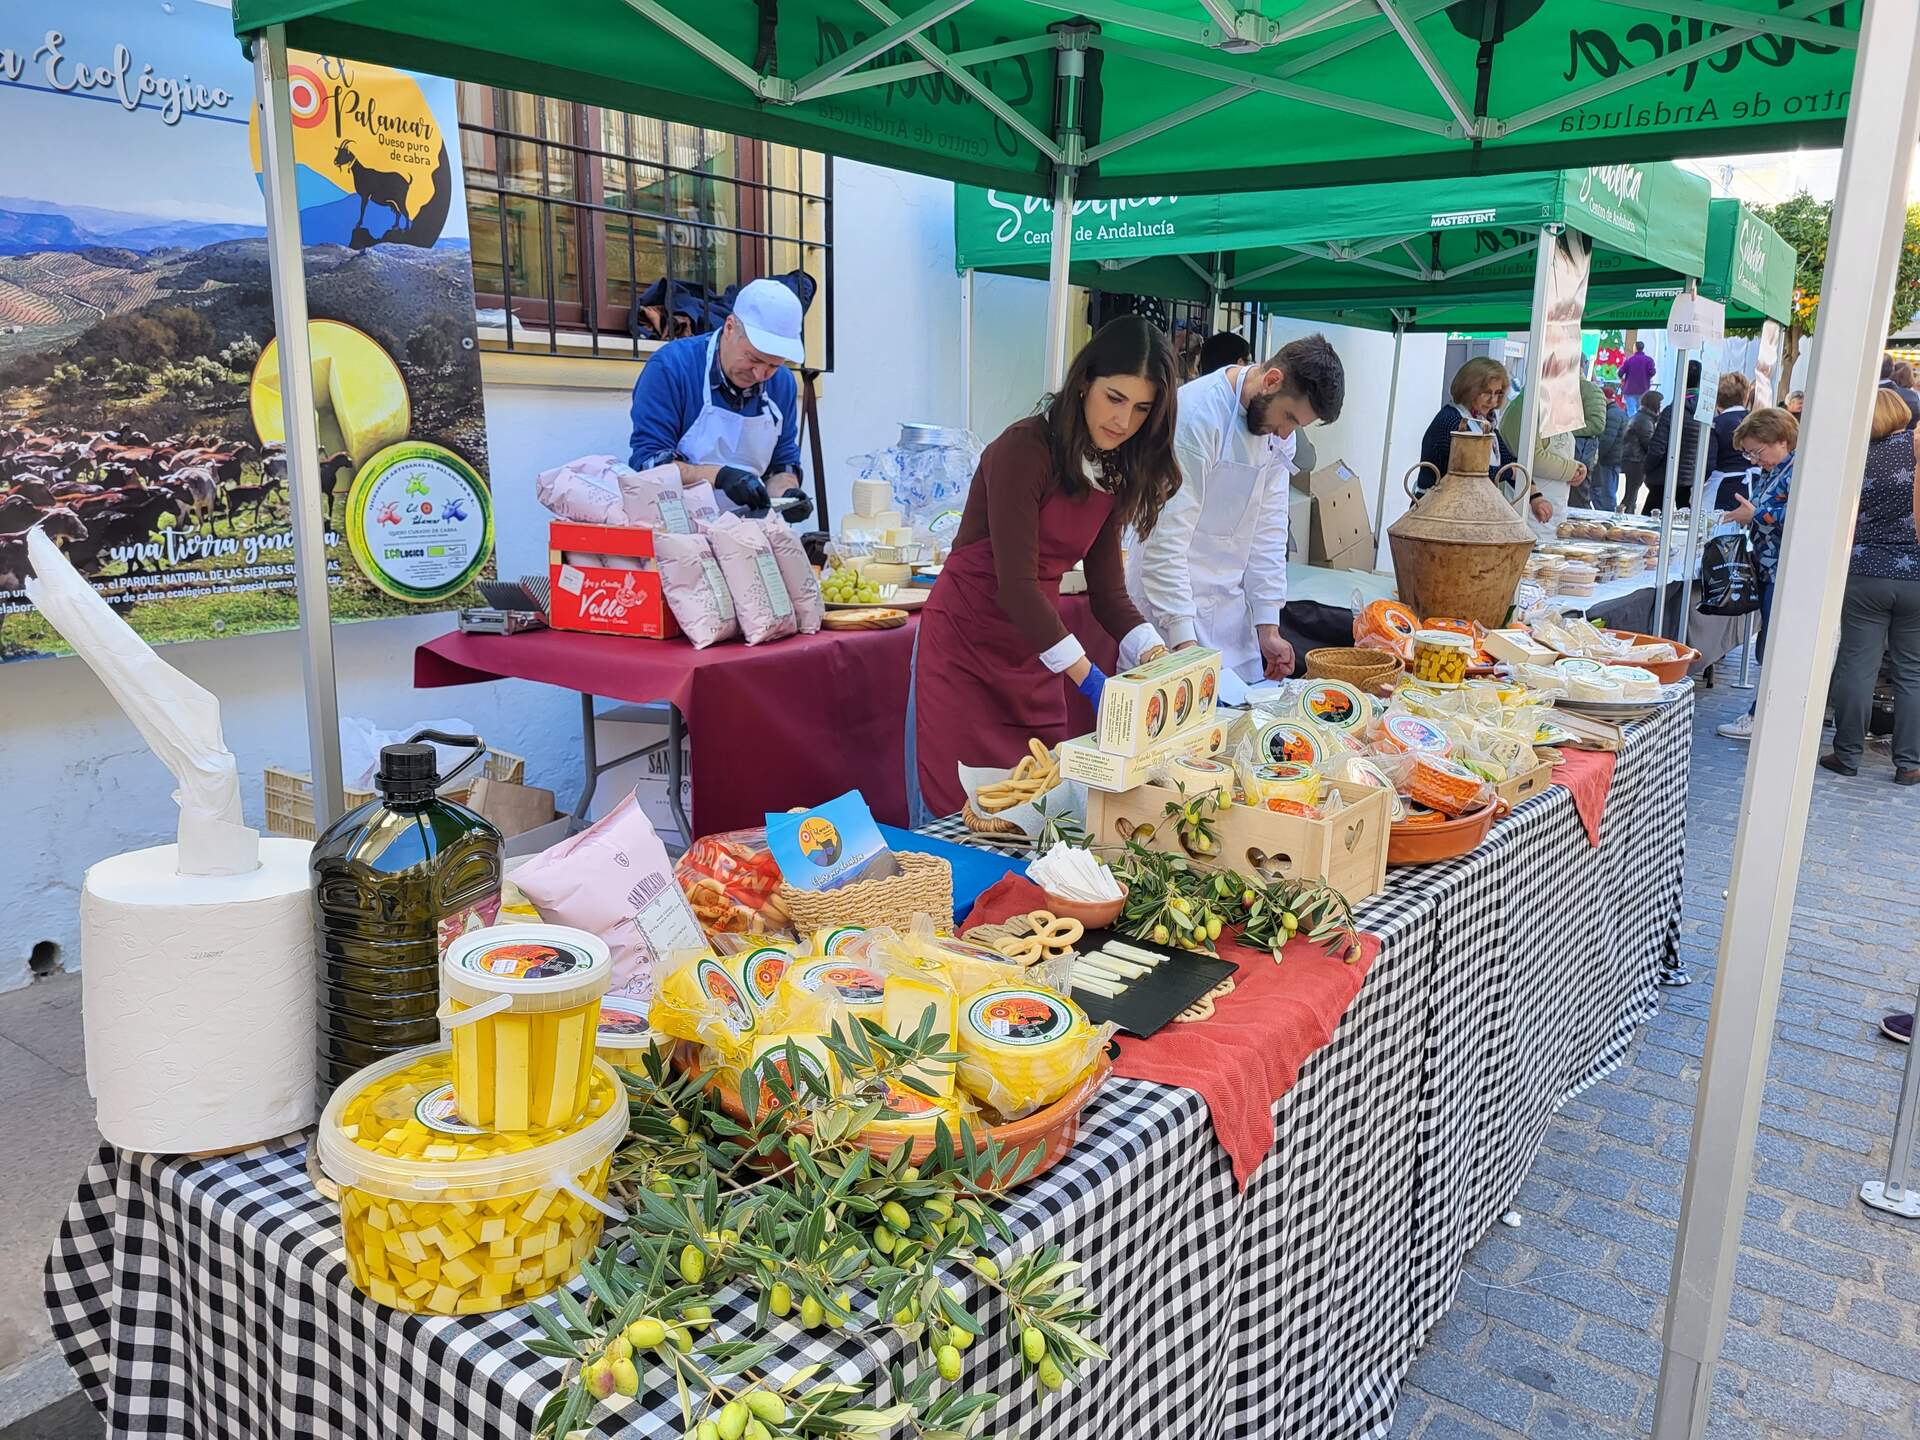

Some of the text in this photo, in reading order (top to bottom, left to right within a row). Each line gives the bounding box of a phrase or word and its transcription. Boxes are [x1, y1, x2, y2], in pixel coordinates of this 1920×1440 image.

[33, 30, 235, 125] Ecológico
[321, 85, 433, 140] Palancar
[378, 133, 430, 154] Queso puro
[390, 149, 431, 165] de cabra
[1075, 226, 1092, 242] de
[1096, 220, 1176, 241] Andalucía
[110, 540, 163, 563] una
[159, 525, 241, 566] tierra
[120, 573, 162, 589] PARQUE
[162, 570, 208, 586] NATURAL
[210, 570, 223, 580] DE
[224, 567, 242, 579] LAS
[244, 565, 284, 579] SIERRAS
[122, 592, 136, 604] de
[137, 589, 166, 603] cabra
[166, 584, 212, 600] ecológico
[213, 583, 229, 595] tan
[229, 578, 267, 595] especial
[268, 578, 293, 590] como
[579, 588, 628, 618] Valle
[627, 883, 648, 911] SAN
